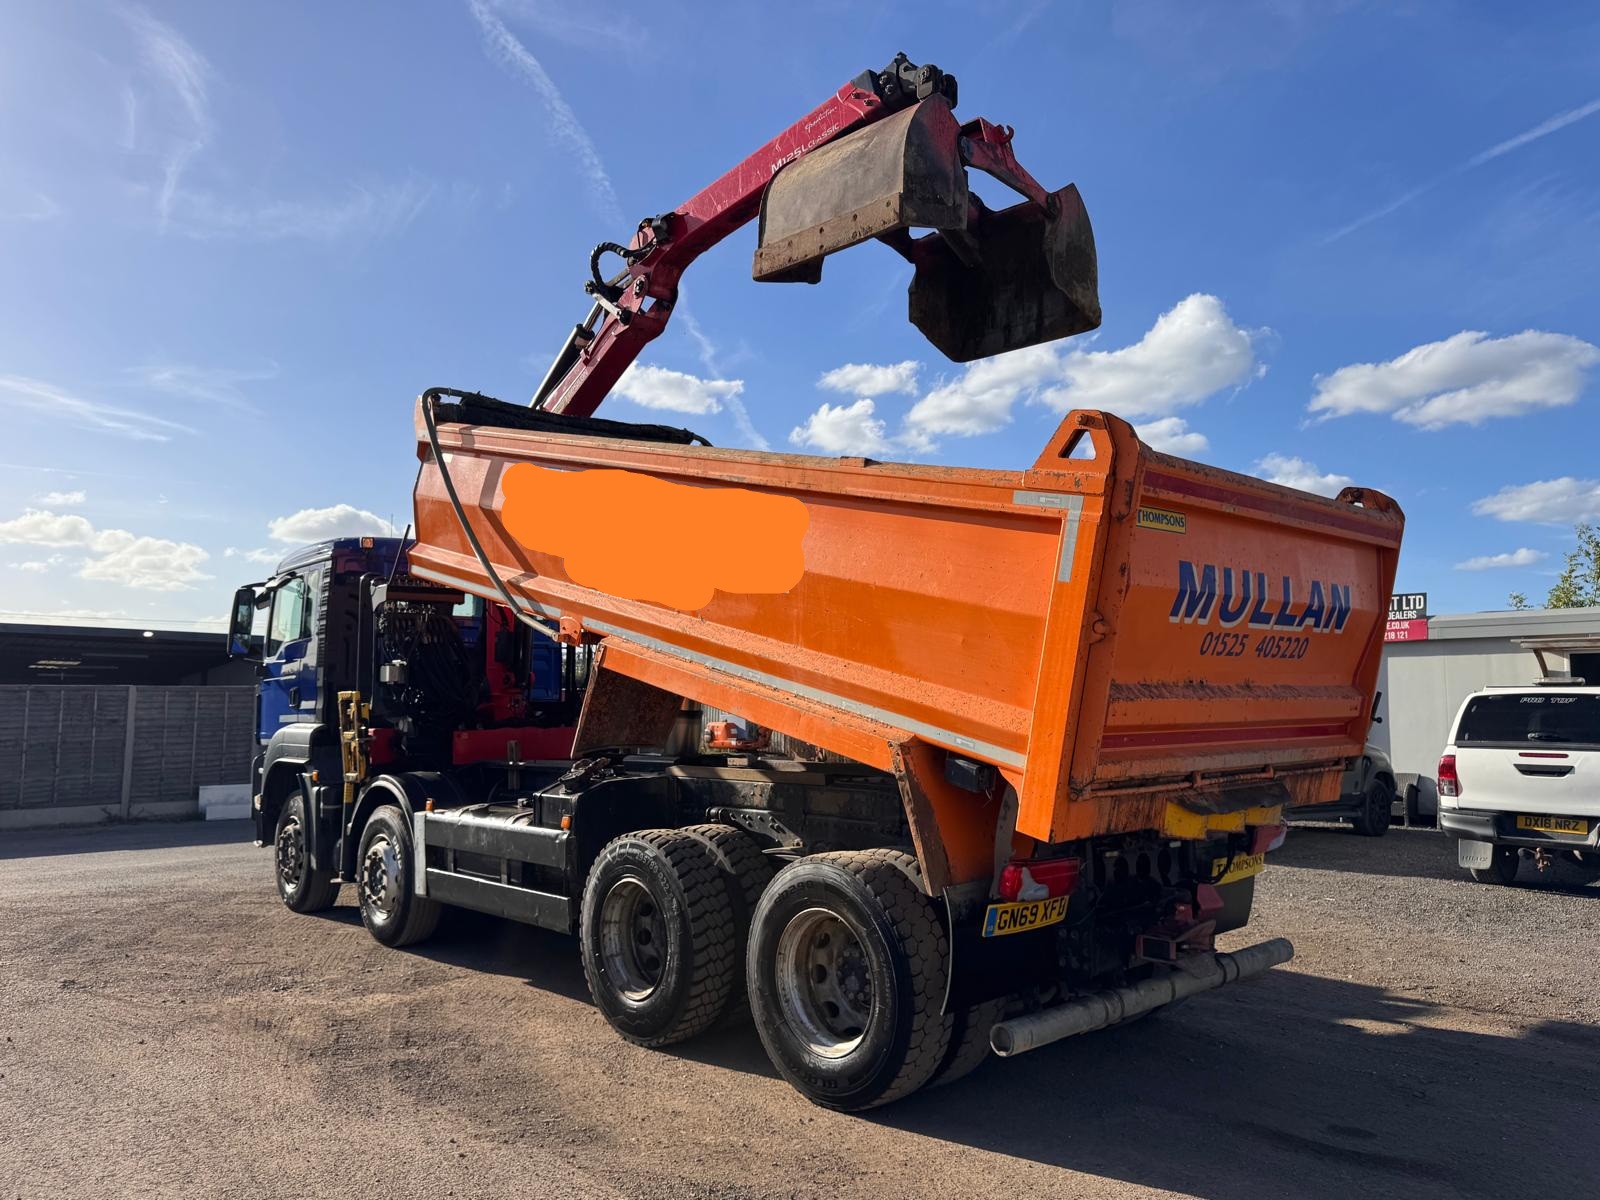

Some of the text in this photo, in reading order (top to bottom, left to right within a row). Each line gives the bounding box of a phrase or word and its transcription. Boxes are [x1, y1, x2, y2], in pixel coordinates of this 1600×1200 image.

[1168, 560, 1352, 634] MULLAN
[1402, 595, 1424, 610] LTD
[1200, 631, 1310, 660] 01525 405220
[997, 904, 1039, 931] GN69
